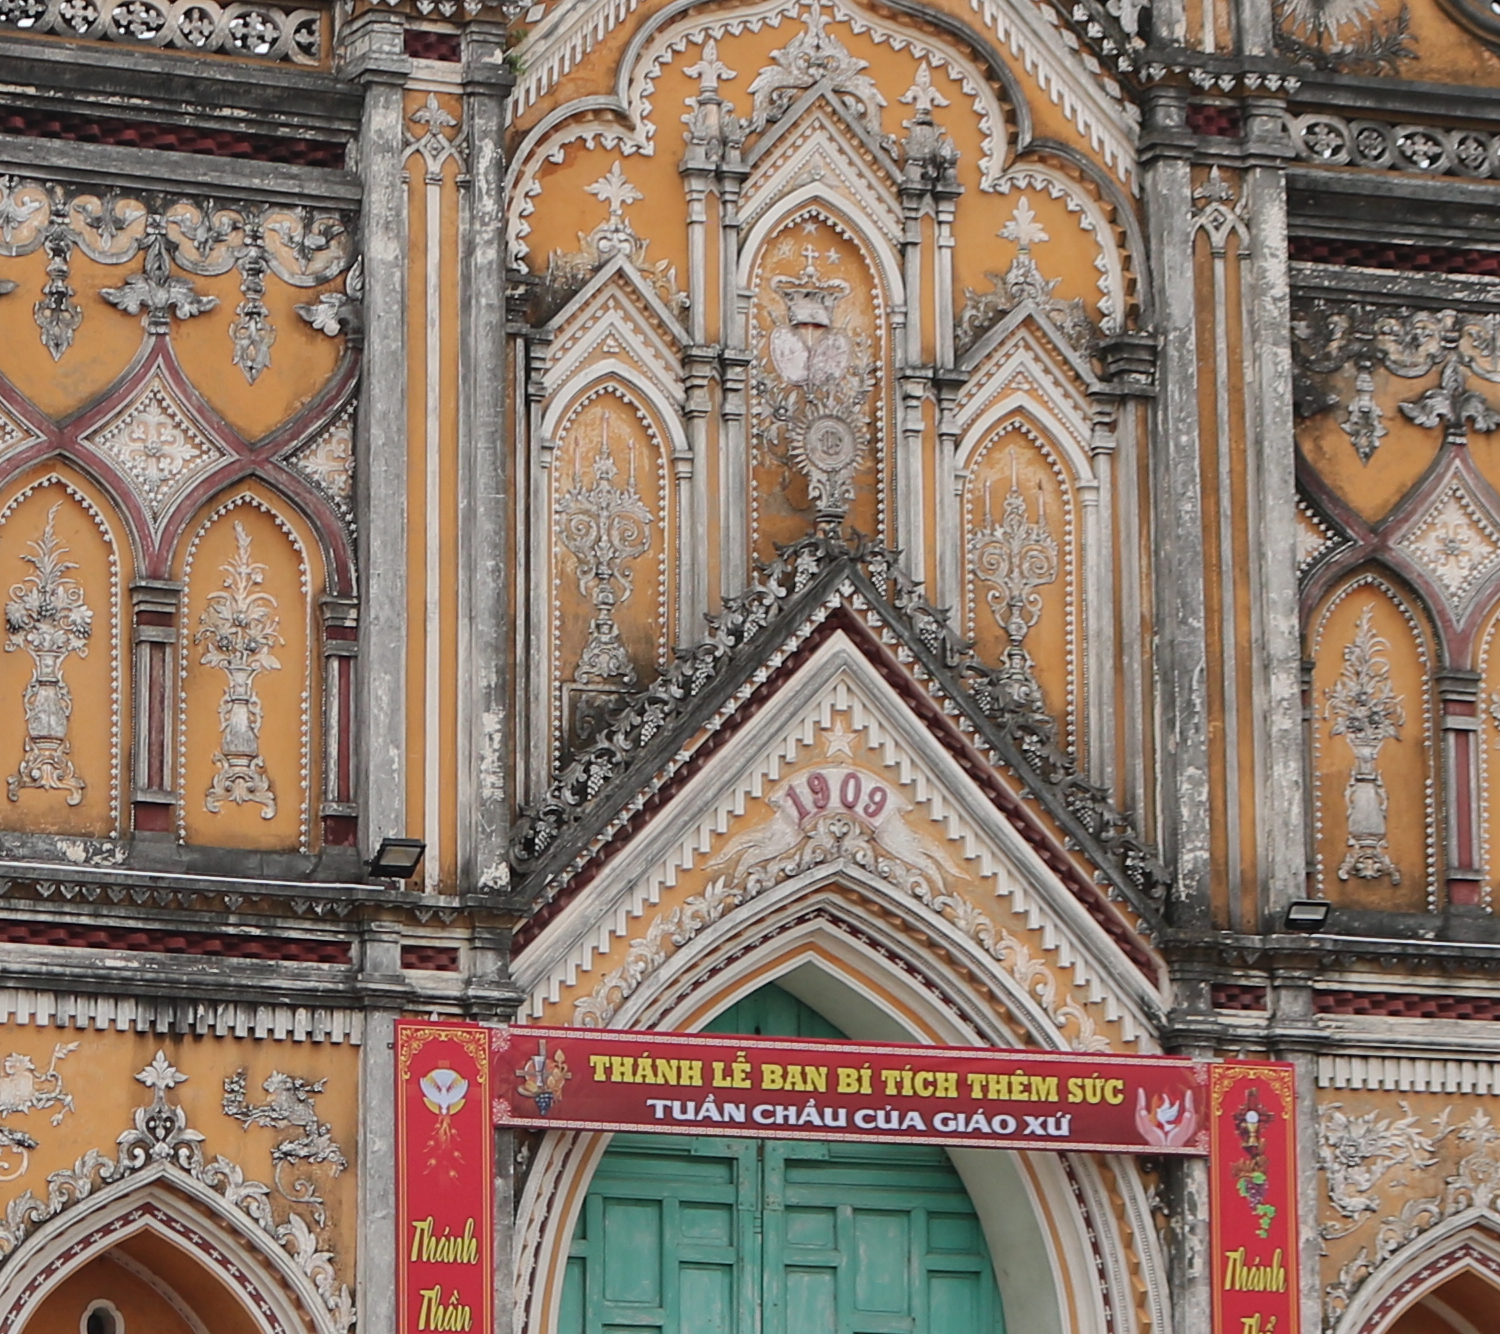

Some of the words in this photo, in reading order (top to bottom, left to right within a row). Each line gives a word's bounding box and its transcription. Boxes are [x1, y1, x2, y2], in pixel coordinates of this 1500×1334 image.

[785, 772, 888, 821] 1909
[590, 1052, 703, 1087] THÁNH
[712, 1051, 751, 1089] LỄ
[761, 1063, 828, 1092] BAN
[837, 1063, 872, 1095] BÍ
[881, 1065, 959, 1098] TÍCH
[967, 1069, 1059, 1102] THÊM
[1067, 1073, 1125, 1105] SỨC
[646, 1094, 746, 1123] TUẦN
[752, 1098, 848, 1127] CHẦU
[853, 1105, 927, 1131] CỦA
[932, 1108, 1017, 1134] GIÁO
[1022, 1111, 1072, 1136] XỨ
[411, 1216, 479, 1264] Thánh
[1224, 1247, 1286, 1292] Thánh
[418, 1284, 473, 1332] Thần
